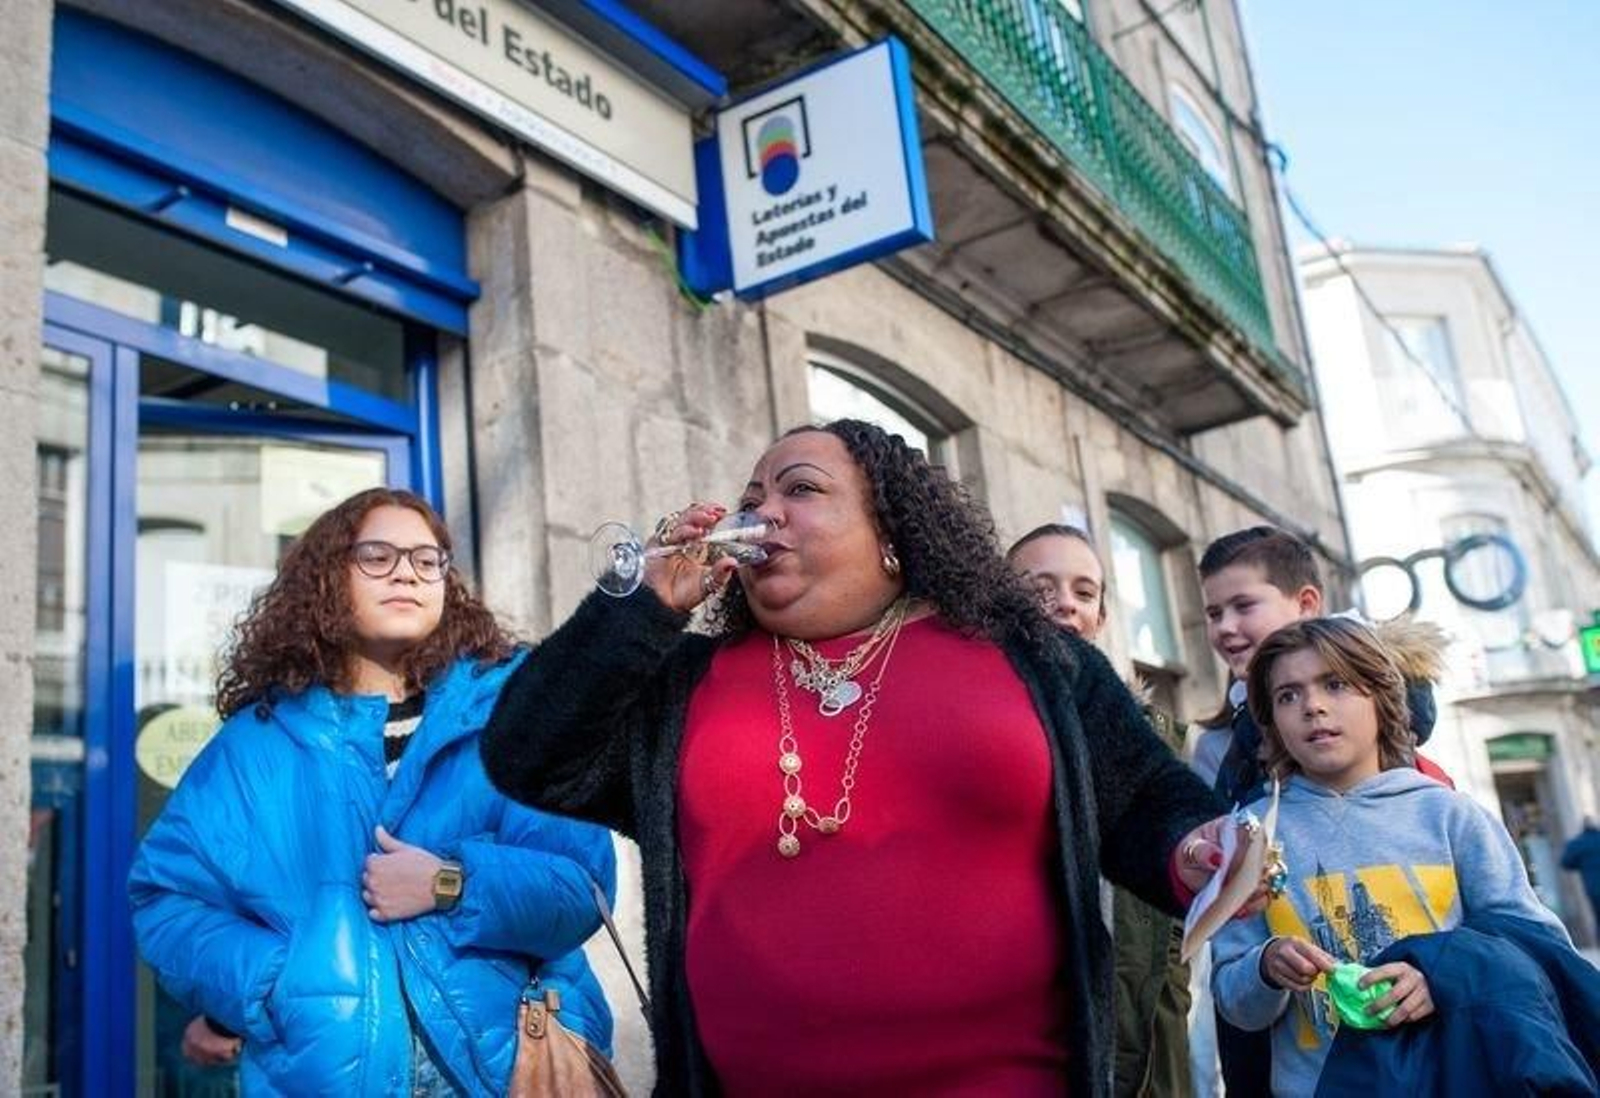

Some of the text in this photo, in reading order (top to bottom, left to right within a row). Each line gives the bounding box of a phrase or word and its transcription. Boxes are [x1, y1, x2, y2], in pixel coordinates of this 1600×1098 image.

[433, 0, 489, 46] del
[502, 23, 613, 121] Estado
[827, 184, 837, 203] y
[841, 190, 867, 215] del
[757, 236, 815, 269] Estado
